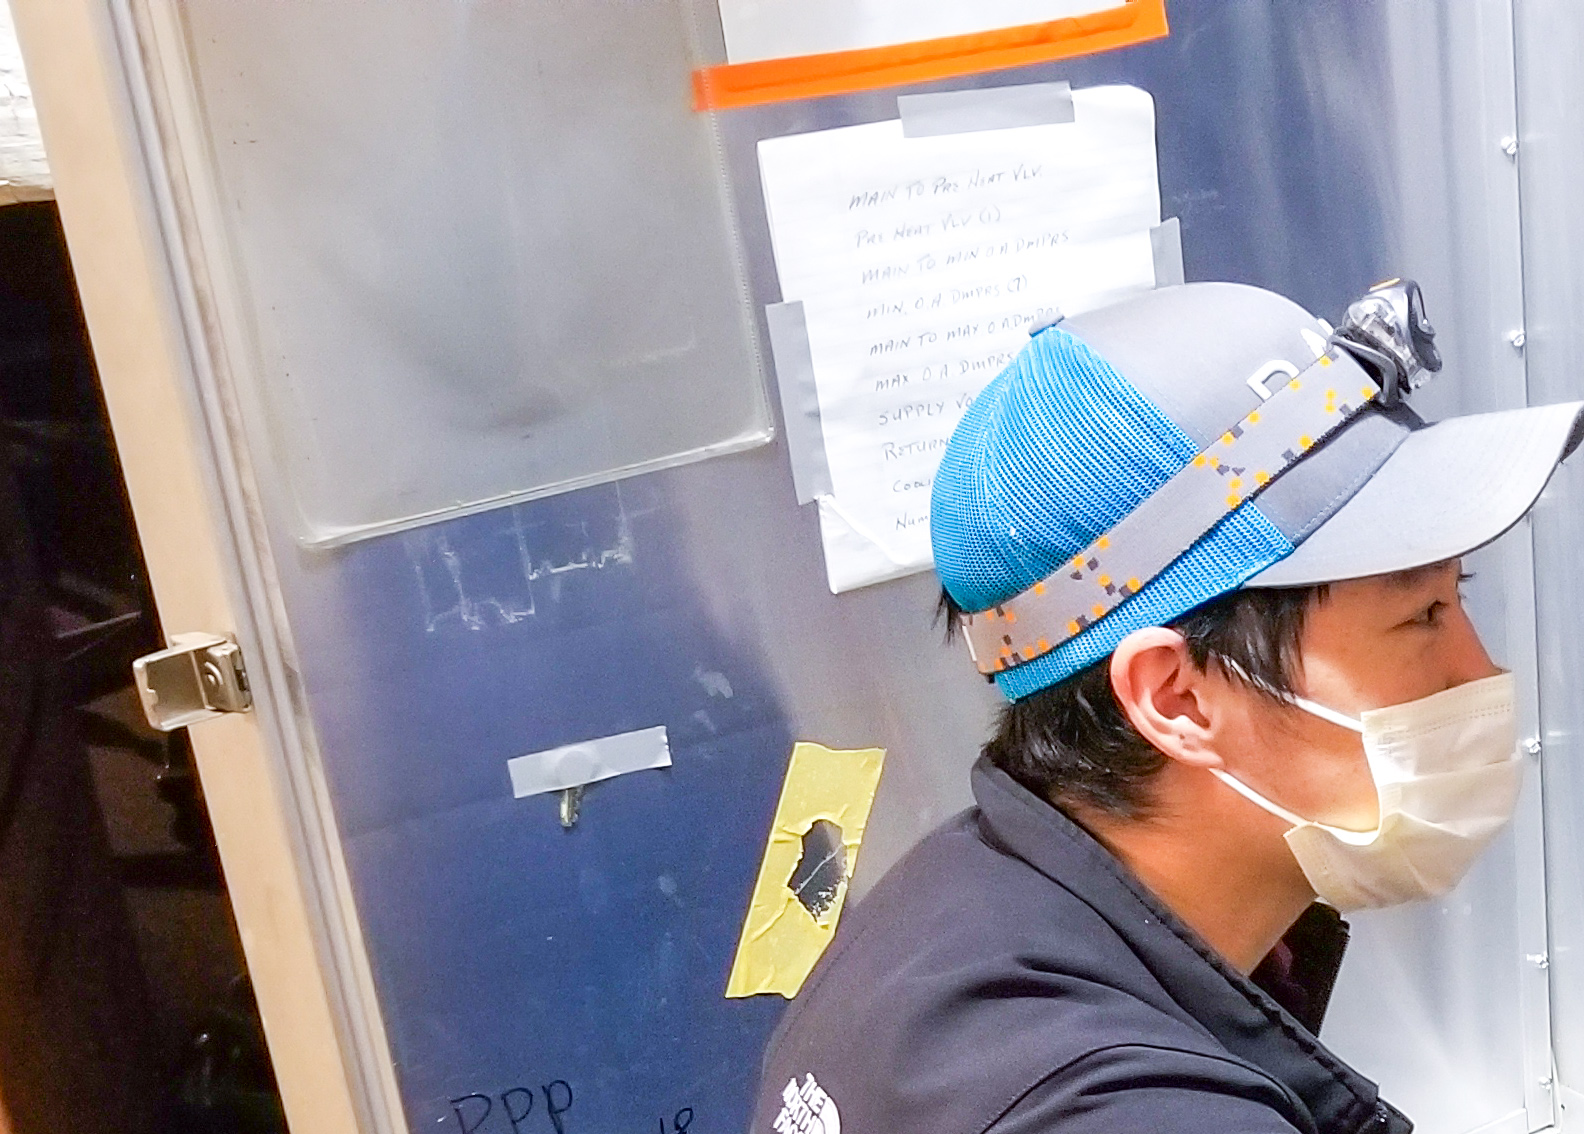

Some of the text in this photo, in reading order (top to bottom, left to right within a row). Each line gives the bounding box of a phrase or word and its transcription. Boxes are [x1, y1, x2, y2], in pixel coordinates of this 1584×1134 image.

[848, 183, 898, 211] MAIN
[905, 179, 925, 200] TO
[861, 264, 909, 285] MAIN
[916, 252, 936, 272] TO
[945, 246, 980, 265] MIN
[869, 336, 911, 356] MAIN
[917, 331, 938, 347] TO
[946, 323, 980, 341] MAX
[875, 373, 909, 391] MAX
[878, 400, 945, 426] SUPPLY
